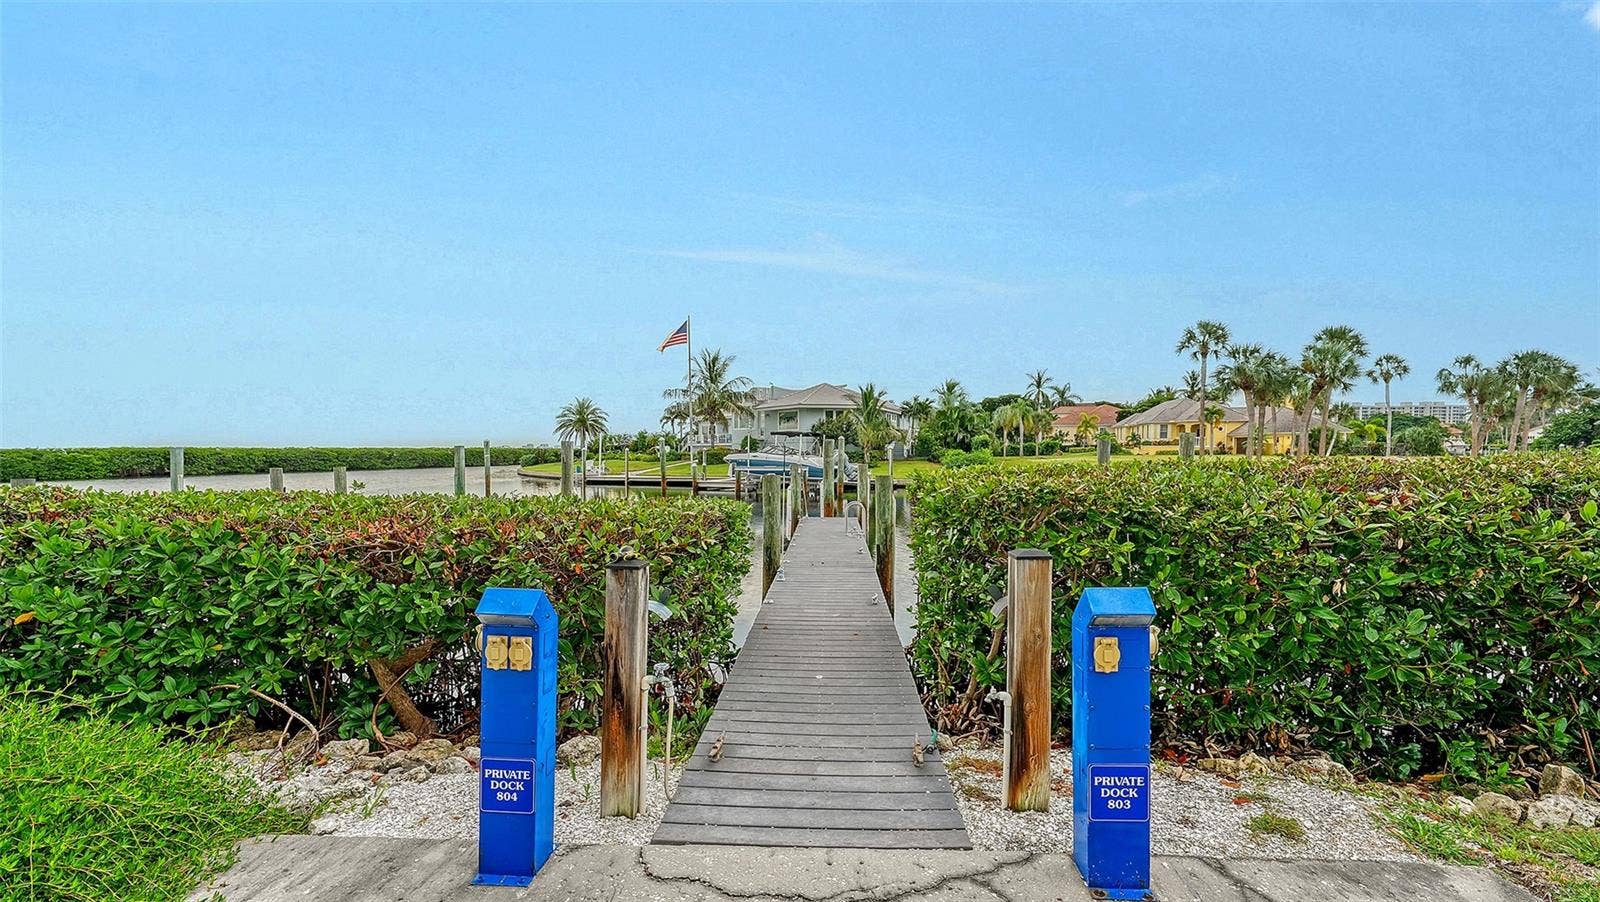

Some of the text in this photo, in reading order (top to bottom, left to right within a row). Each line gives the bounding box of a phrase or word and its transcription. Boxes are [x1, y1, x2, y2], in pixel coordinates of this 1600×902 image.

[485, 768, 530, 780] PRIVATE
[490, 780, 524, 790] DOCK
[1094, 776, 1145, 786] PRIVATE
[496, 792, 518, 802] 804
[1100, 788, 1138, 798] DOCK
[1107, 799, 1131, 809] 803
